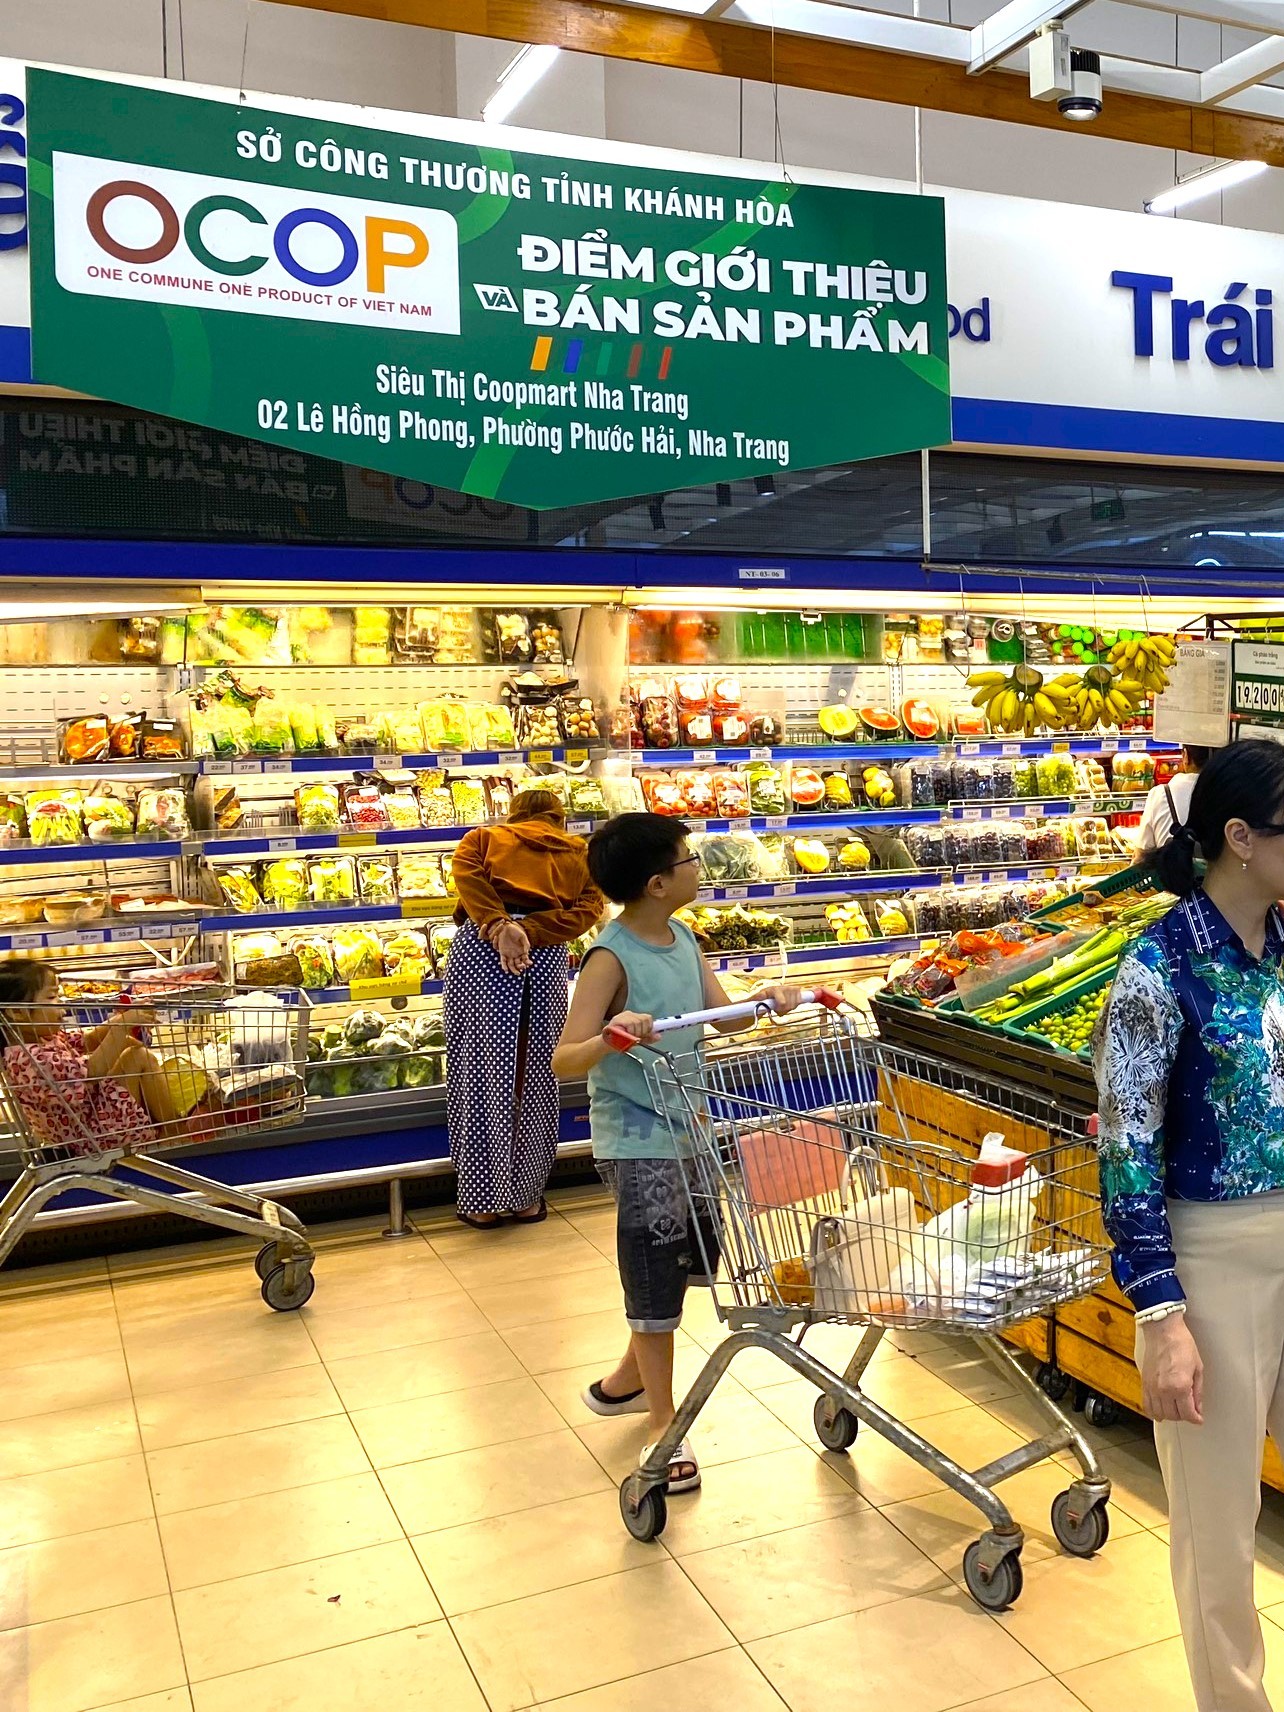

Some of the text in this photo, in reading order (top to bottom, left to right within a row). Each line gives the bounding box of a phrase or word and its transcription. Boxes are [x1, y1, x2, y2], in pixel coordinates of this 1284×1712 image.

[236, 126, 794, 228] SỞ CÔNG THƯƠNG TỈNH KHÁNH HÒA
[86, 180, 430, 294] OCOP
[517, 228, 927, 308] ĐIỂM GIỚI THIỆU
[87, 265, 432, 317] ONE COMMUNE ONE PRODUCT OF VIET NAM
[482, 286, 513, 309] VÀ
[523, 284, 930, 356] BÁN SẢN PHẨM
[1110, 269, 1274, 370] Trái
[377, 364, 689, 421] Siêu Thị Coopmart Nha Trang
[257, 400, 790, 467] 02 Lê Hồng Phong, Phường Phước Hải, Nha Trang
[1237, 685, 1278, 706] 19.200
